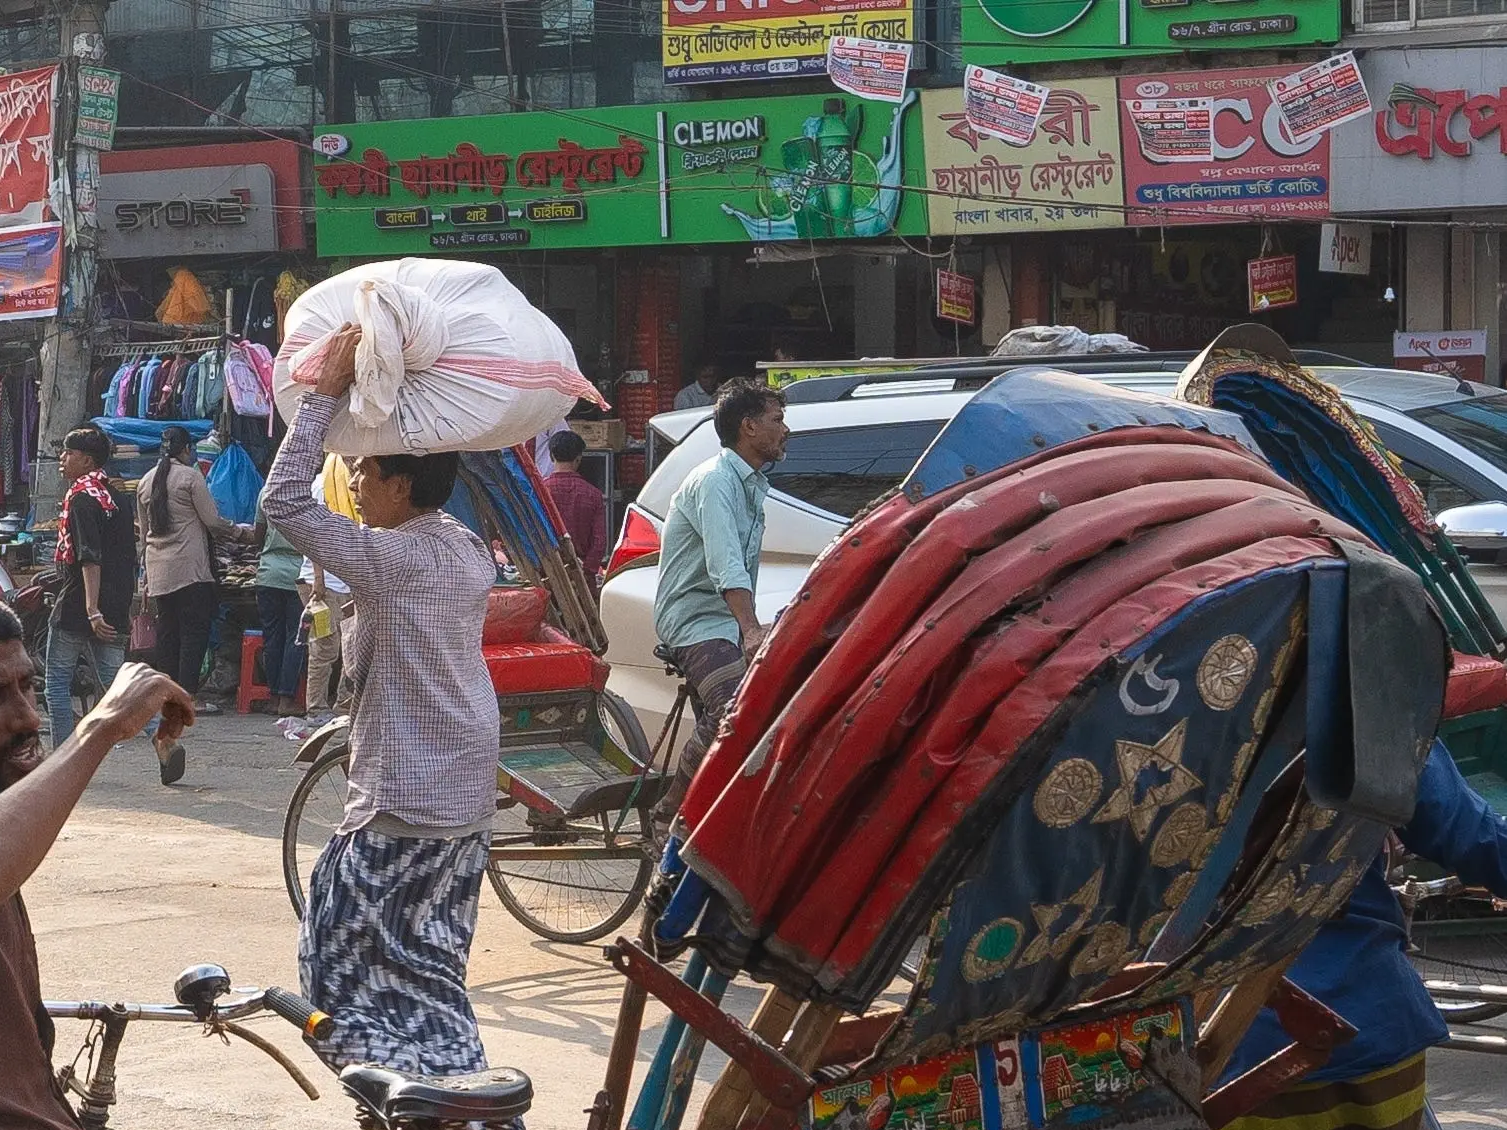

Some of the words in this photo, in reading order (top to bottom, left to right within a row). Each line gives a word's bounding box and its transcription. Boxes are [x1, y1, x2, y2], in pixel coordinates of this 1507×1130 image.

[667, 33, 694, 62] শুধু
[694, 24, 758, 55] মেডিকেল
[776, 19, 826, 49] ডেন্টাল
[673, 116, 761, 146] CLEMON
[932, 154, 1023, 199] ছায়ানীড়
[1030, 150, 1116, 200] রেস্টুরেন্ট
[1166, 183, 1243, 200] বিশ্ববিদ্যালয়
[1245, 178, 1274, 196] ভর্তি
[1278, 176, 1322, 195] কোচিং
[114, 196, 247, 231] STORE
[952, 209, 990, 225] বাংলা
[994, 206, 1039, 224] খাবার,
[1330, 224, 1361, 271] Apex
